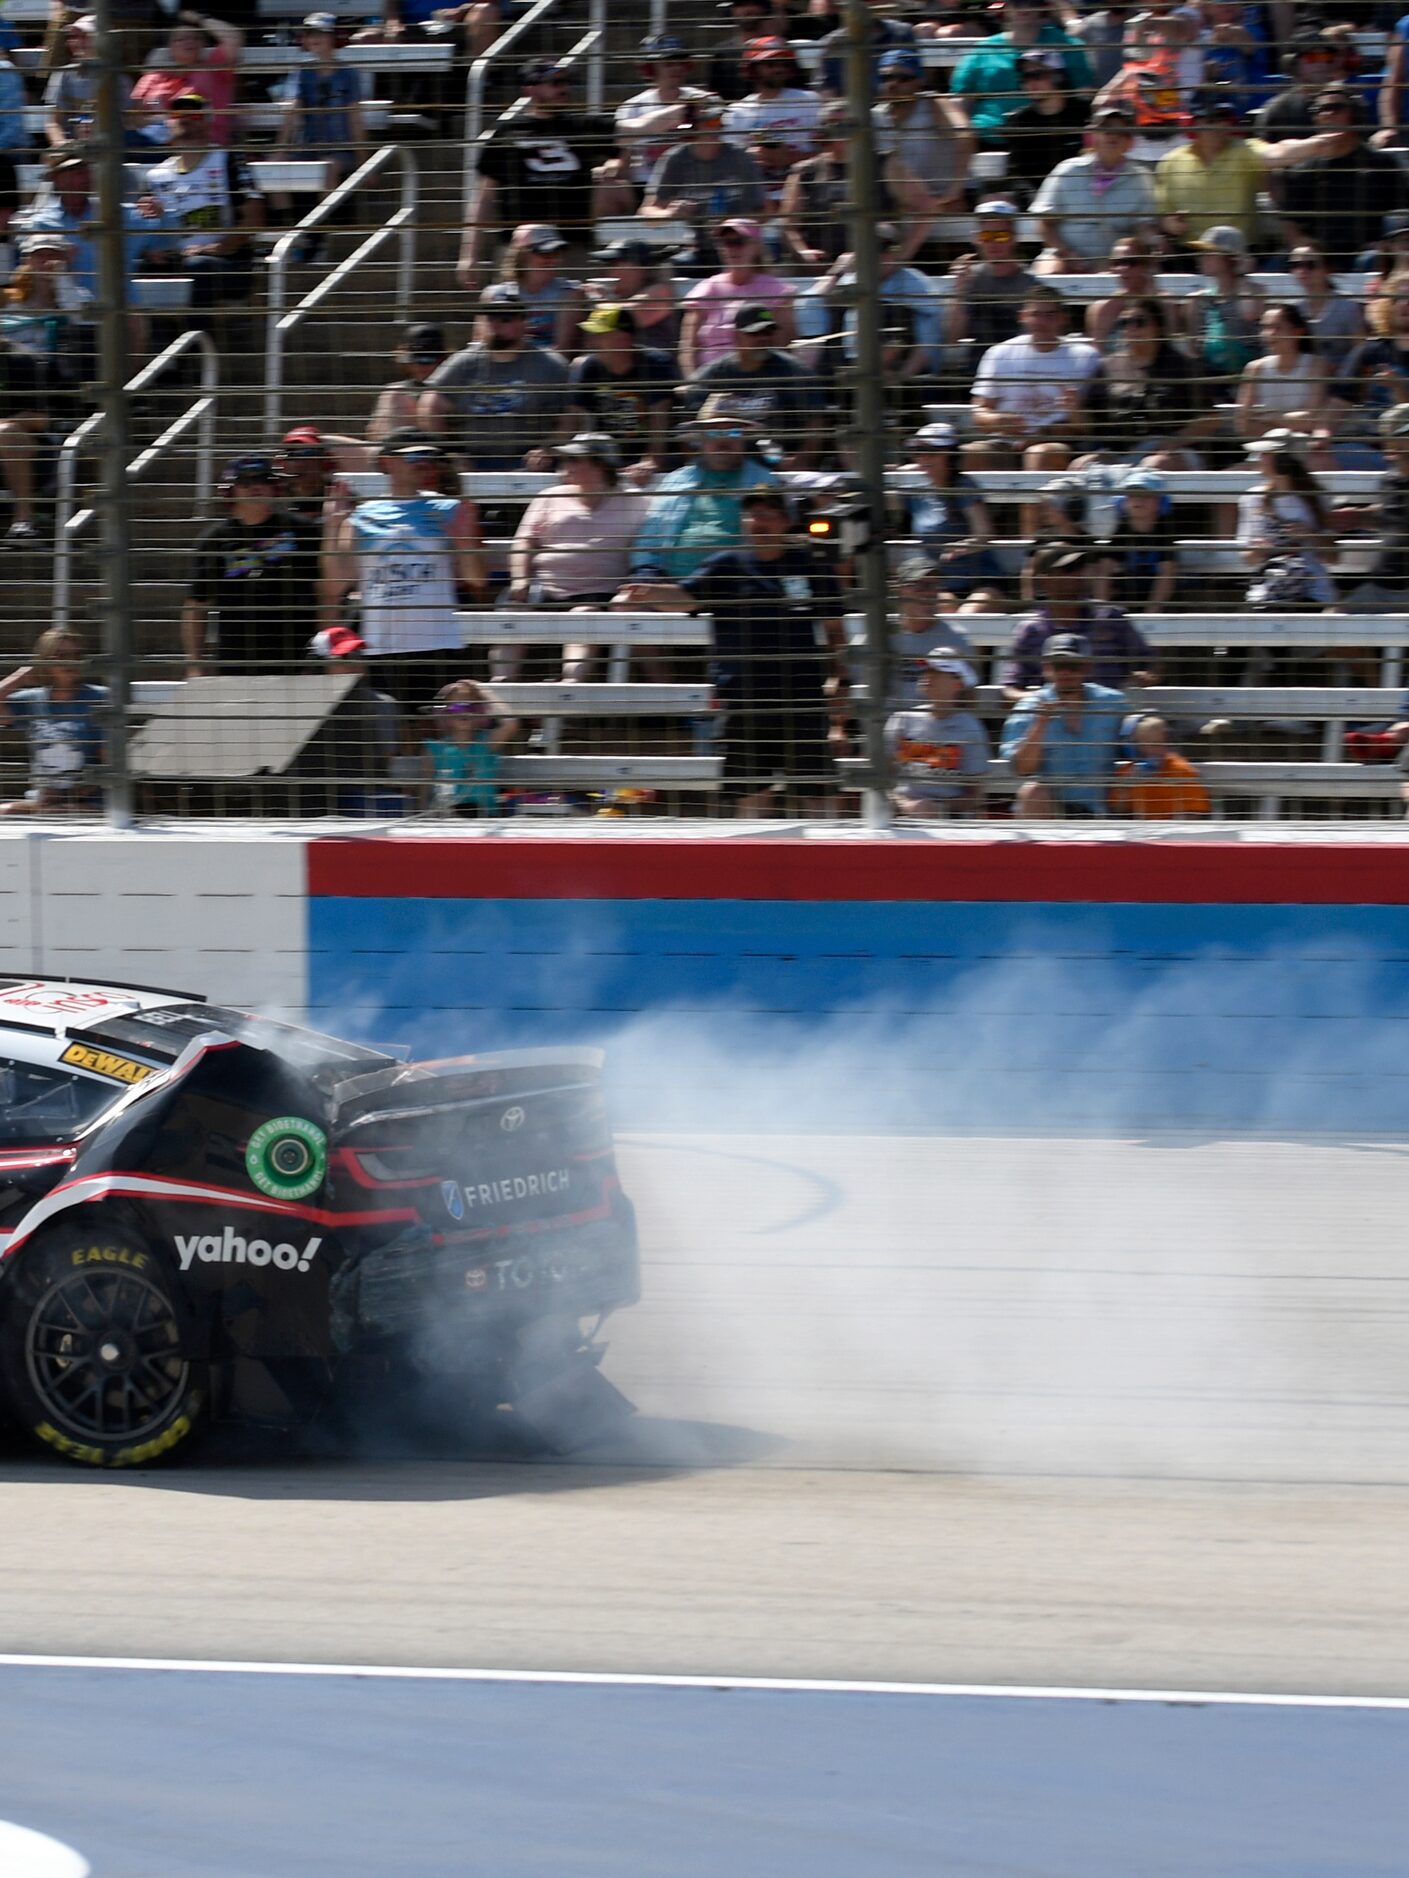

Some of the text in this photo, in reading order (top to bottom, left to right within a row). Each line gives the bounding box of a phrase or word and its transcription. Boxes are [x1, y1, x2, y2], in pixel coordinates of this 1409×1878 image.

[63, 1044, 153, 1085] DEWAL
[464, 1168, 570, 1208] FRIEDRICH
[71, 1246, 149, 1269] EAGLE
[174, 1226, 322, 1272] yahoo!
